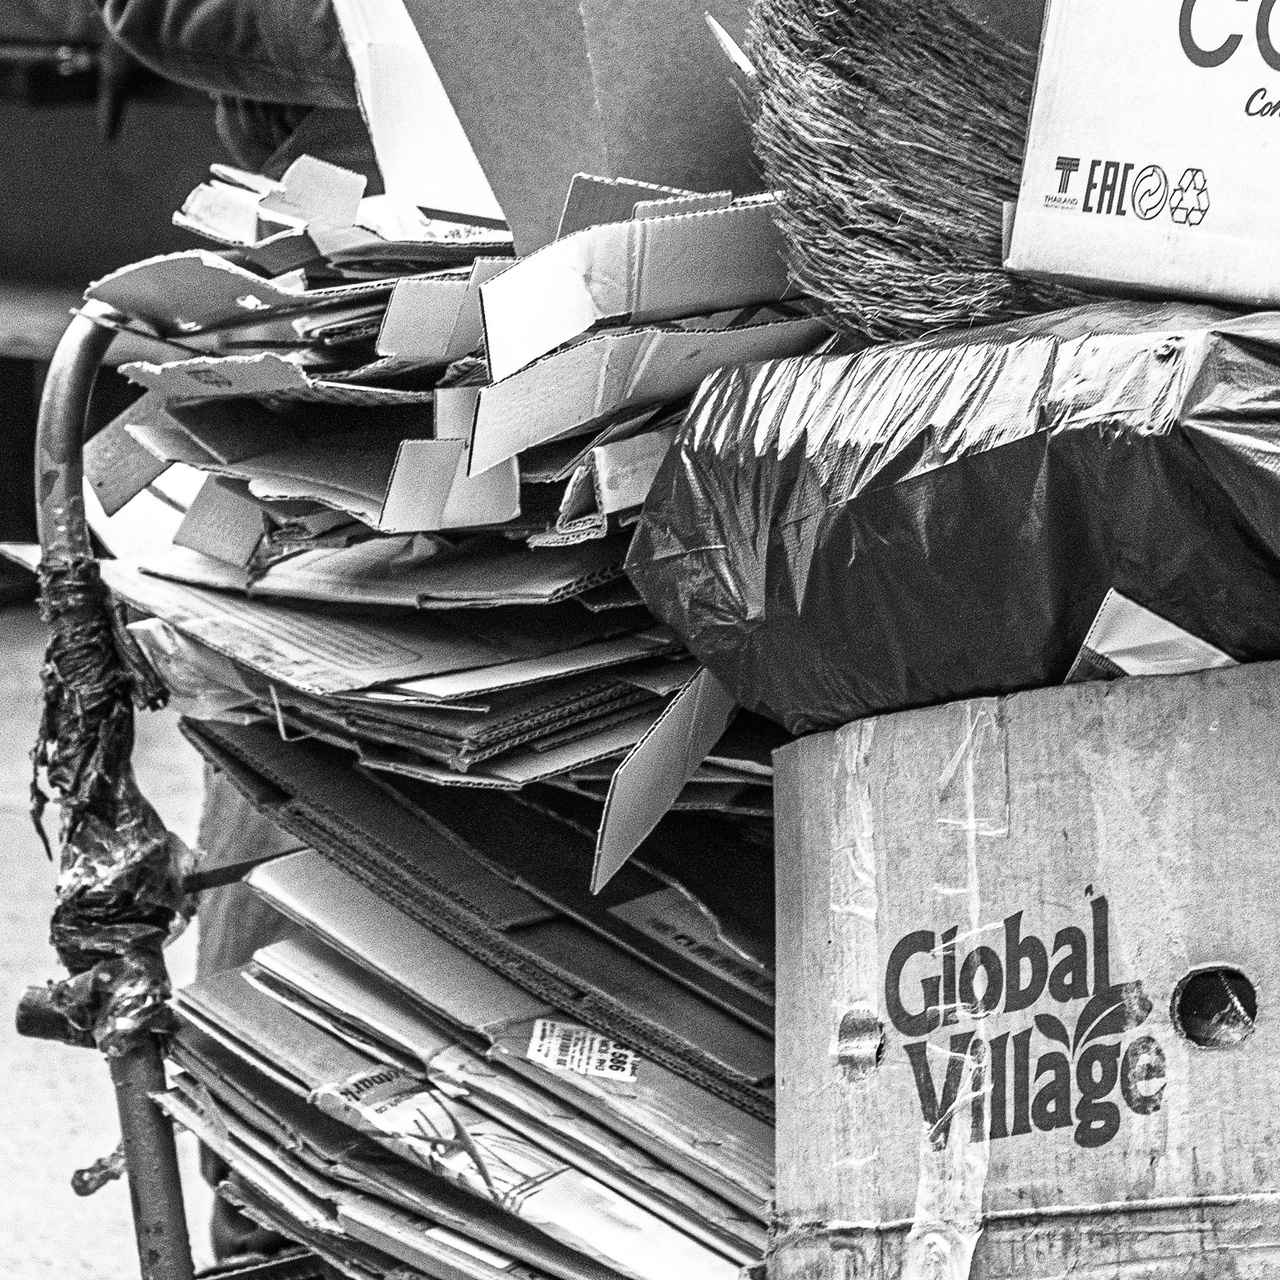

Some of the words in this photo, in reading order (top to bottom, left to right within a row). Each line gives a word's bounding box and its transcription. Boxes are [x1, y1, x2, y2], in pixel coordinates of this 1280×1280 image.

[1044, 194, 1079, 206] THAILAND
[885, 894, 1145, 1037] Global
[903, 1025, 1168, 1152] Village
